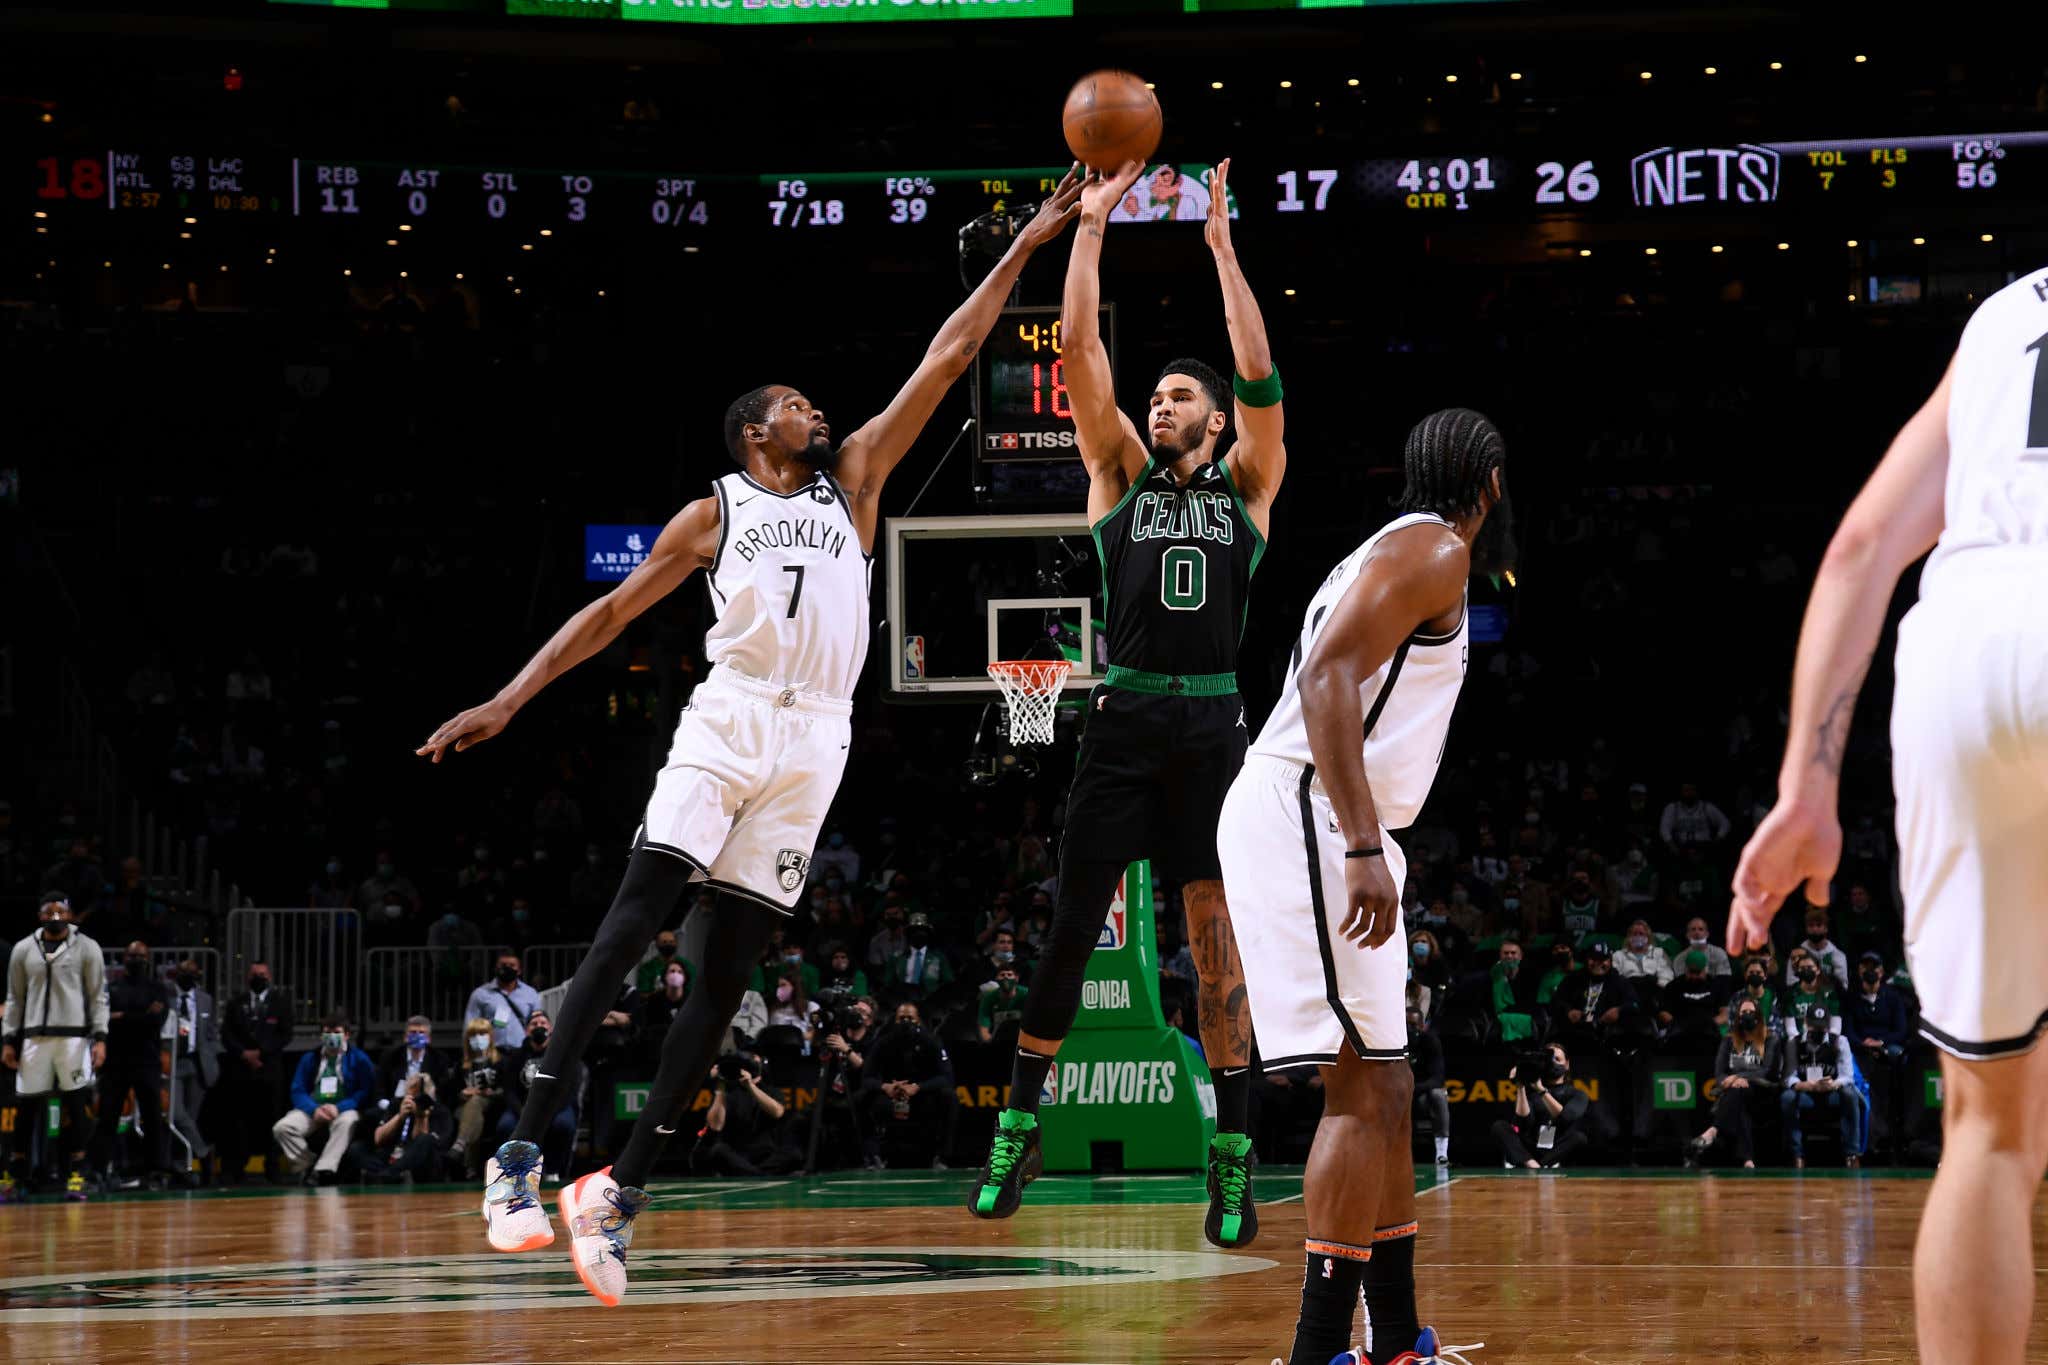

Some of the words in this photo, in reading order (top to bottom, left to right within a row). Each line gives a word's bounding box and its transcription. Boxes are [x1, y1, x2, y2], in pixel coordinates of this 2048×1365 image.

[115, 154, 138, 169] NY
[1808, 151, 1847, 167] TOL
[1871, 148, 1908, 164] FLS
[1953, 140, 2006, 161] FG%
[207, 158, 242, 174] LAC
[316, 165, 360, 186] REB
[1397, 157, 1496, 192] 4:01
[1644, 148, 1769, 206] NETS
[1882, 168, 1897, 188] 3
[1957, 162, 1997, 189] 56
[37, 157, 105, 200] 18
[397, 169, 440, 188] AST
[482, 172, 518, 192] STL
[561, 175, 593, 194] TO
[656, 178, 696, 198] 3PT
[778, 179, 808, 199] FG
[886, 176, 935, 196] FG%
[980, 180, 1013, 194] TOL
[1040, 179, 1057, 192] FL
[1276, 169, 1338, 212] 17
[1535, 160, 1600, 204] 26
[1819, 171, 1835, 190] 7
[321, 187, 360, 214] 11
[408, 190, 427, 216] 0
[487, 193, 507, 219] 0
[567, 196, 586, 222] 3
[651, 199, 708, 225] 0/4
[890, 197, 927, 224] 39
[1405, 189, 1447, 209] QTR
[1455, 191, 1469, 211] 1
[1020, 431, 1078, 448] TISS
[1131, 489, 1234, 546] CELTICS
[735, 518, 847, 562] BROOKLYN
[1161, 546, 1206, 611] 0
[782, 565, 805, 619] 7
[1082, 980, 1131, 1009] @NBA
[1060, 1061, 1176, 1105] PLAYOFFS
[1444, 1079, 1599, 1102] GARN
[1658, 1078, 1693, 1103] TD
